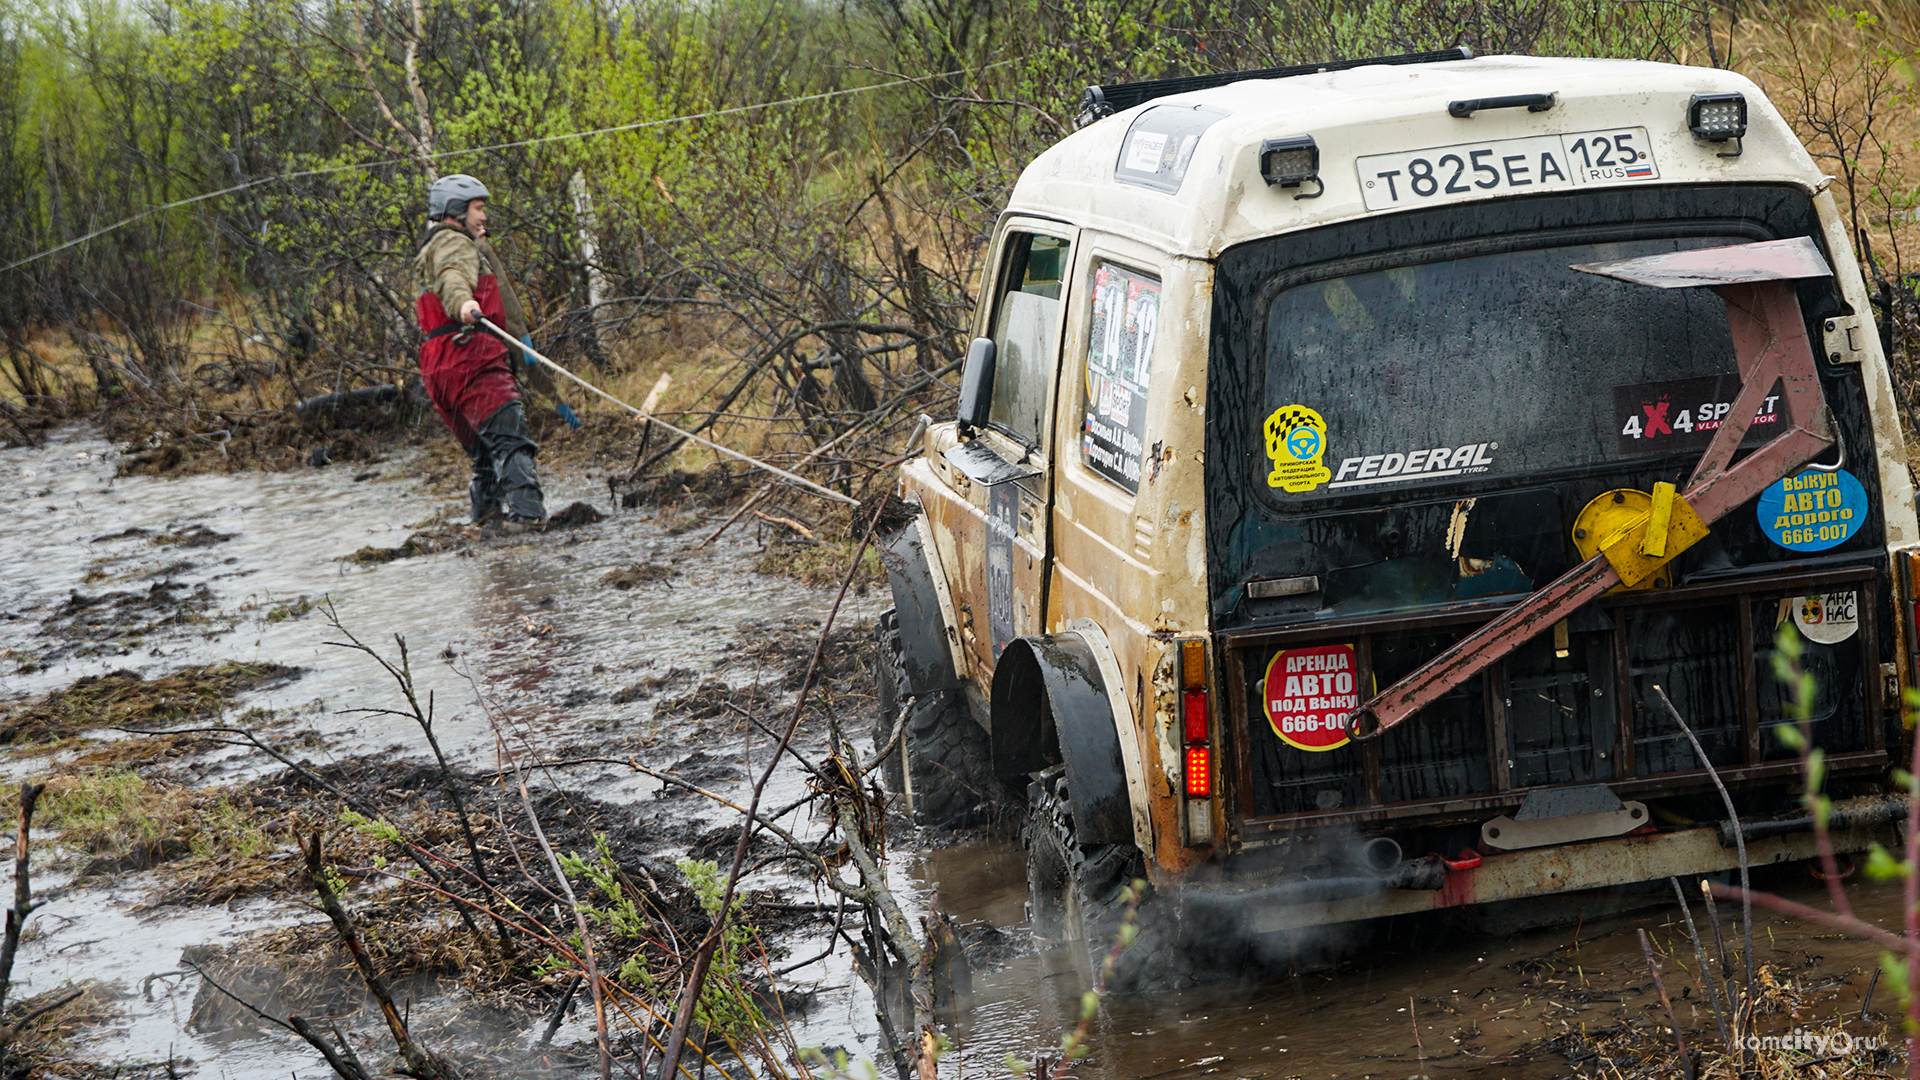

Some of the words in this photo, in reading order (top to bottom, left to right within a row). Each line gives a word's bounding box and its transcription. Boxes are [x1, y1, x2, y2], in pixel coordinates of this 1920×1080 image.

[1377, 148, 1566, 202] Т825ЕА
[1570, 134, 1639, 168] 125
[1589, 167, 1625, 182] RUS
[1133, 301, 1157, 389] 12
[1698, 395, 1779, 421] SPT
[1335, 443, 1494, 481] FEDERAL
[1273, 472, 1326, 482] АВТОМОБИЛЬНОГО
[1783, 488, 1842, 513] АВТО
[1781, 523, 1848, 545] 666-007
[1826, 591, 1854, 606] АНА
[1826, 604, 1856, 621] НАС
[1286, 653, 1349, 673] АРЕНДА
[1284, 672, 1353, 697] АВТО
